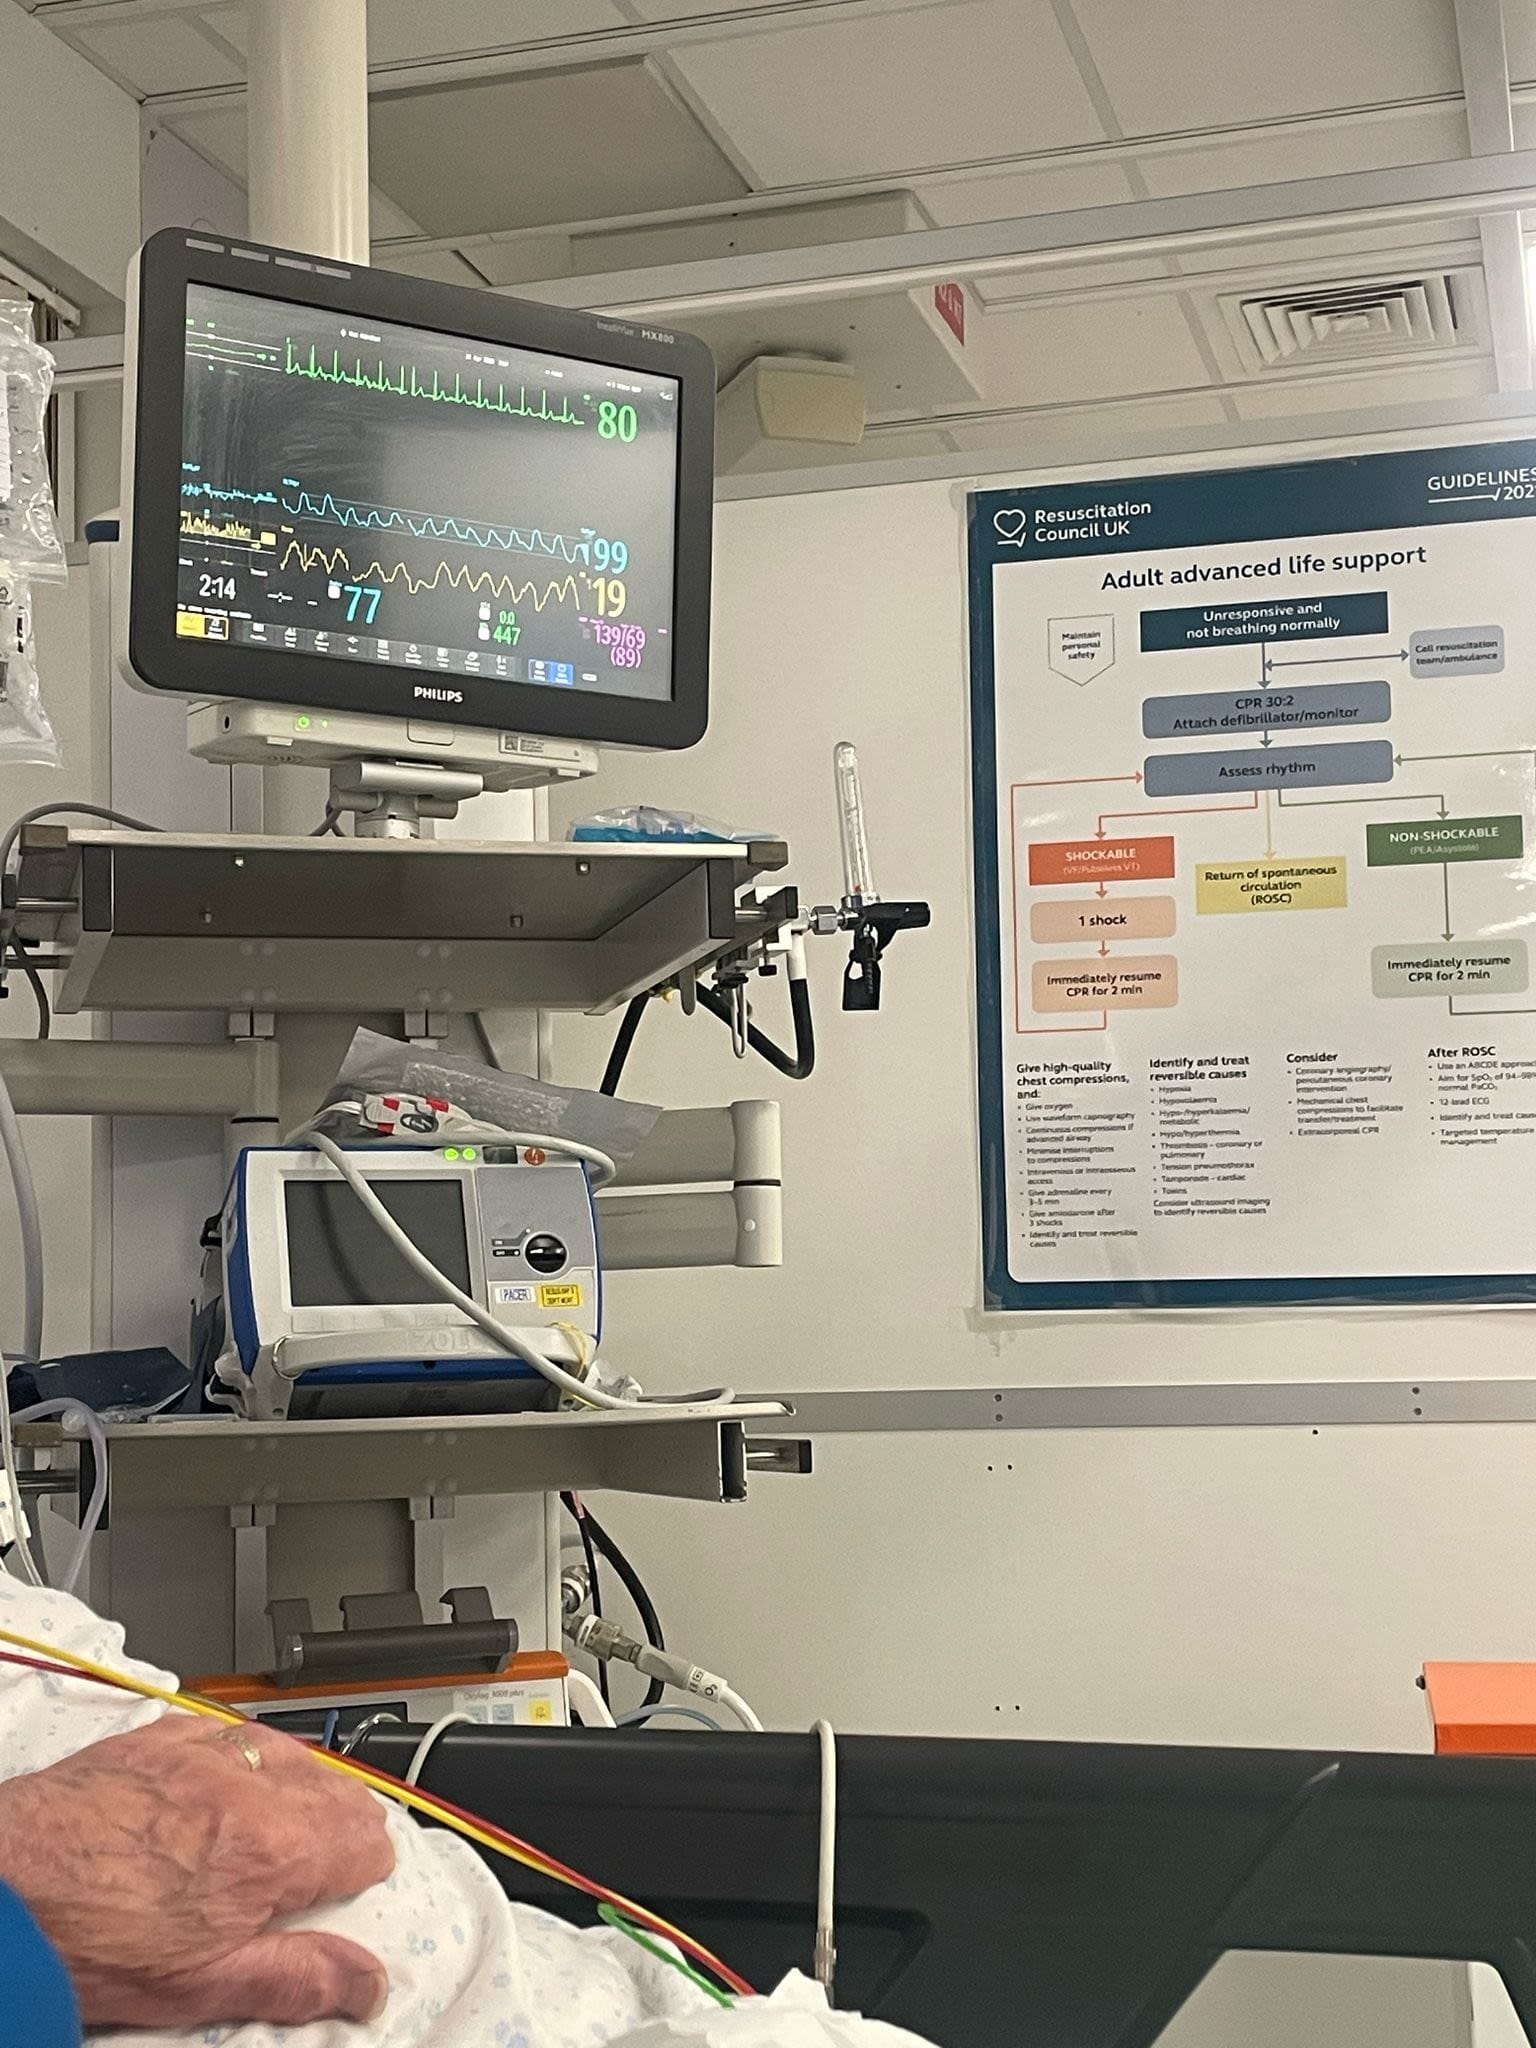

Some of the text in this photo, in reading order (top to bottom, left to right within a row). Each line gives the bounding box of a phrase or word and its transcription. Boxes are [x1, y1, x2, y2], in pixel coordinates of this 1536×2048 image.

[641, 329, 675, 344] MX800
[598, 401, 638, 443] 80
[1503, 484, 1536, 501] 202
[1035, 502, 1152, 524] Resuscitation
[1035, 520, 1131, 542] Council UK
[593, 537, 629, 574] 99
[1101, 546, 1427, 591] Adult advanced life support
[199, 574, 237, 600] 2:14
[592, 577, 627, 618] 19
[344, 585, 382, 624] 77
[1203, 602, 1323, 622] Unresponsive and
[1186, 617, 1341, 639] not breathing normally
[493, 627, 521, 646] 447
[594, 624, 646, 649] 139/69
[1062, 630, 1101, 641] Maintain
[1062, 640, 1101, 652] personal
[1415, 640, 1498, 653] Call resuscitation
[610, 646, 642, 668] (89)
[1068, 651, 1095, 660] safety
[1416, 653, 1498, 665] team/ambulance
[414, 686, 463, 703] PHILIPS
[1235, 695, 1294, 710] CPR 30:2
[1173, 708, 1359, 730] Attach defibrillator/monitor
[1218, 762, 1316, 778] Assess rhythm
[1389, 826, 1500, 843] NON-SHOCKABLE
[1065, 848, 1137, 862] SHOCKABLE
[1204, 866, 1338, 881] Return of spontaneous
[1240, 881, 1302, 892] circulation
[1251, 893, 1292, 906] (ROSC)
[1078, 913, 1128, 927] 1 shock
[1387, 956, 1511, 970] Immediately resume
[1047, 972, 1162, 986] Immediately resume
[1408, 969, 1491, 982] CPR for 2 min
[1066, 984, 1143, 997] CPR for 2 min
[1286, 1052, 1338, 1063] Consider
[1428, 1046, 1496, 1057] After ROSC
[1016, 1061, 1112, 1074] Give high-quality
[1149, 1056, 1250, 1069] Identify and treat
[1437, 1061, 1498, 1070] Use an ABCDE
[1017, 1073, 1130, 1086] chest compressions,
[1149, 1070, 1247, 1081] reversible causes
[1438, 1074, 1454, 1082] Aim
[1494, 1072, 1503, 1080] of
[1017, 1088, 1041, 1099] and:
[1025, 1103, 1073, 1111] Give oxygen
[1297, 1096, 1368, 1105] Mechanical chest
[1472, 1097, 1490, 1105] ECG
[1297, 1106, 1354, 1115] compressions
[1355, 1105, 1365, 1113] to
[1474, 1112, 1491, 1120] and
[1361, 1126, 1379, 1134] CPR
[1440, 1127, 1535, 1137] Targeted temperature
[1440, 1138, 1498, 1146] management
[1028, 1189, 1045, 1197] Give
[503, 1288, 528, 1301] PACER
